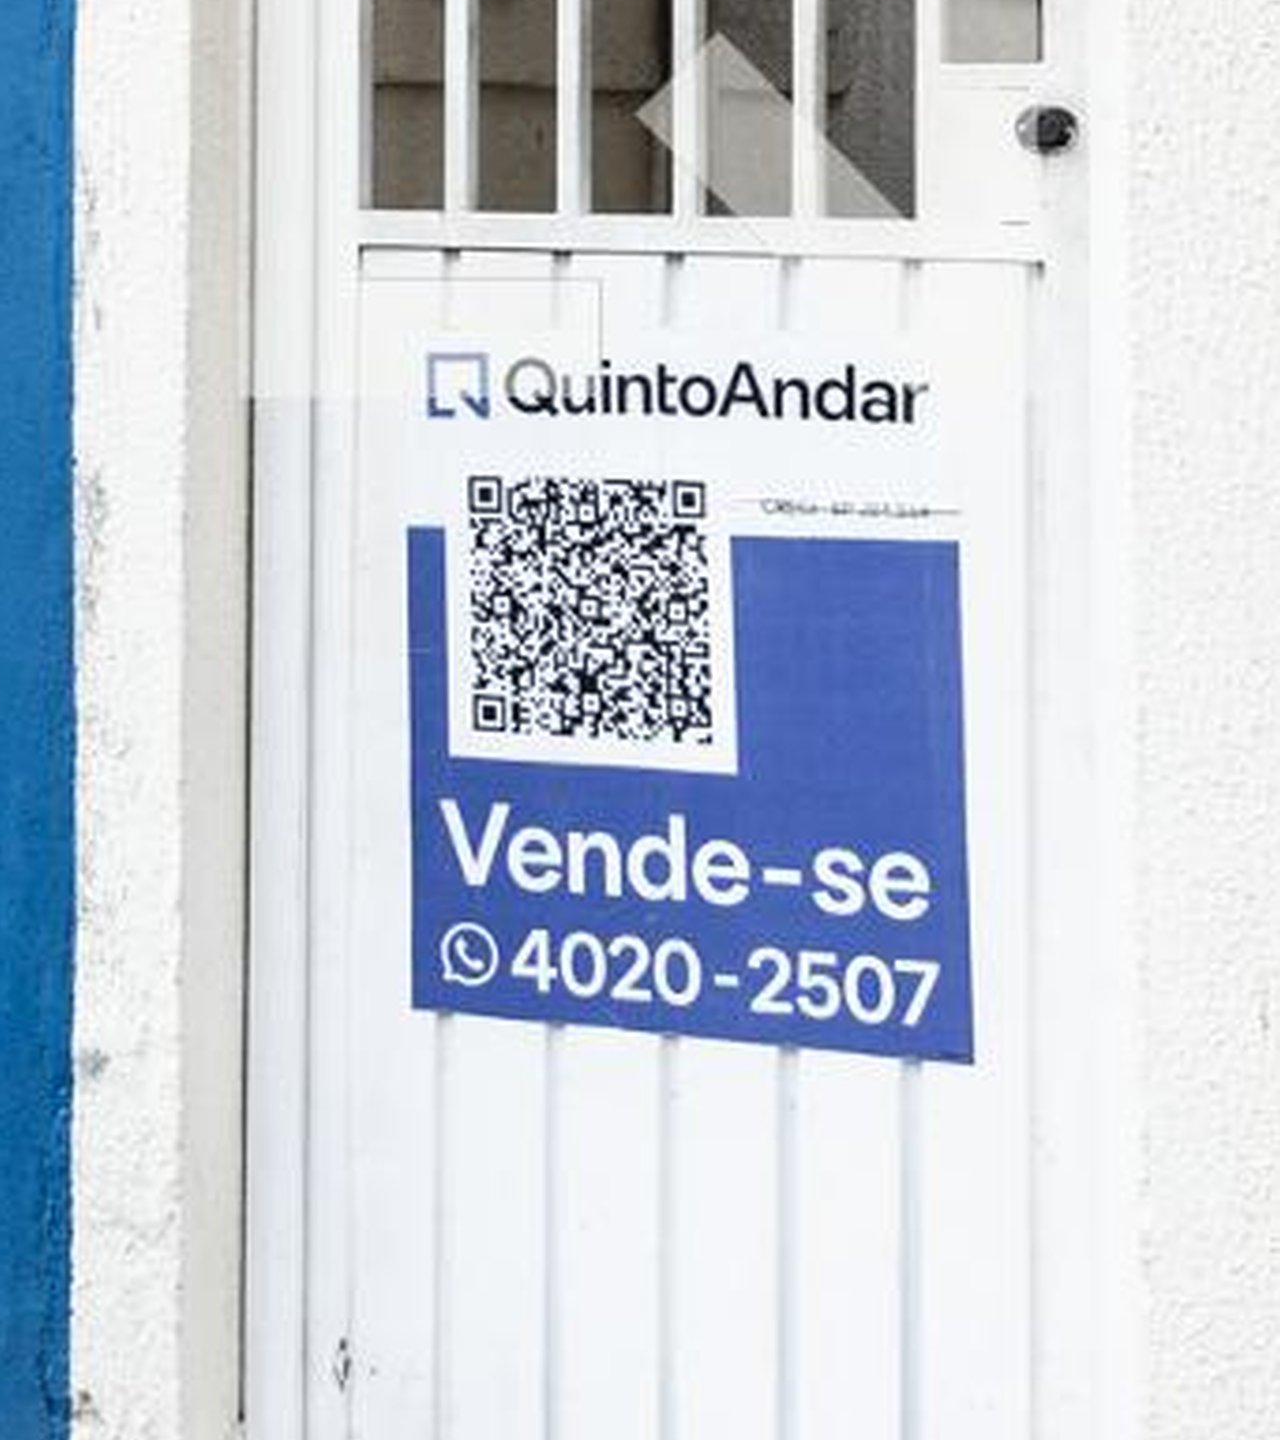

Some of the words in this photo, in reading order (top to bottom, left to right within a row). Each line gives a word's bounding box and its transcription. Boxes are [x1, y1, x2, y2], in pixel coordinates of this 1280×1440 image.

[504, 357, 929, 424] QuintoAndar
[439, 799, 931, 920] Vende-se
[510, 928, 940, 1027] 4020-2507
